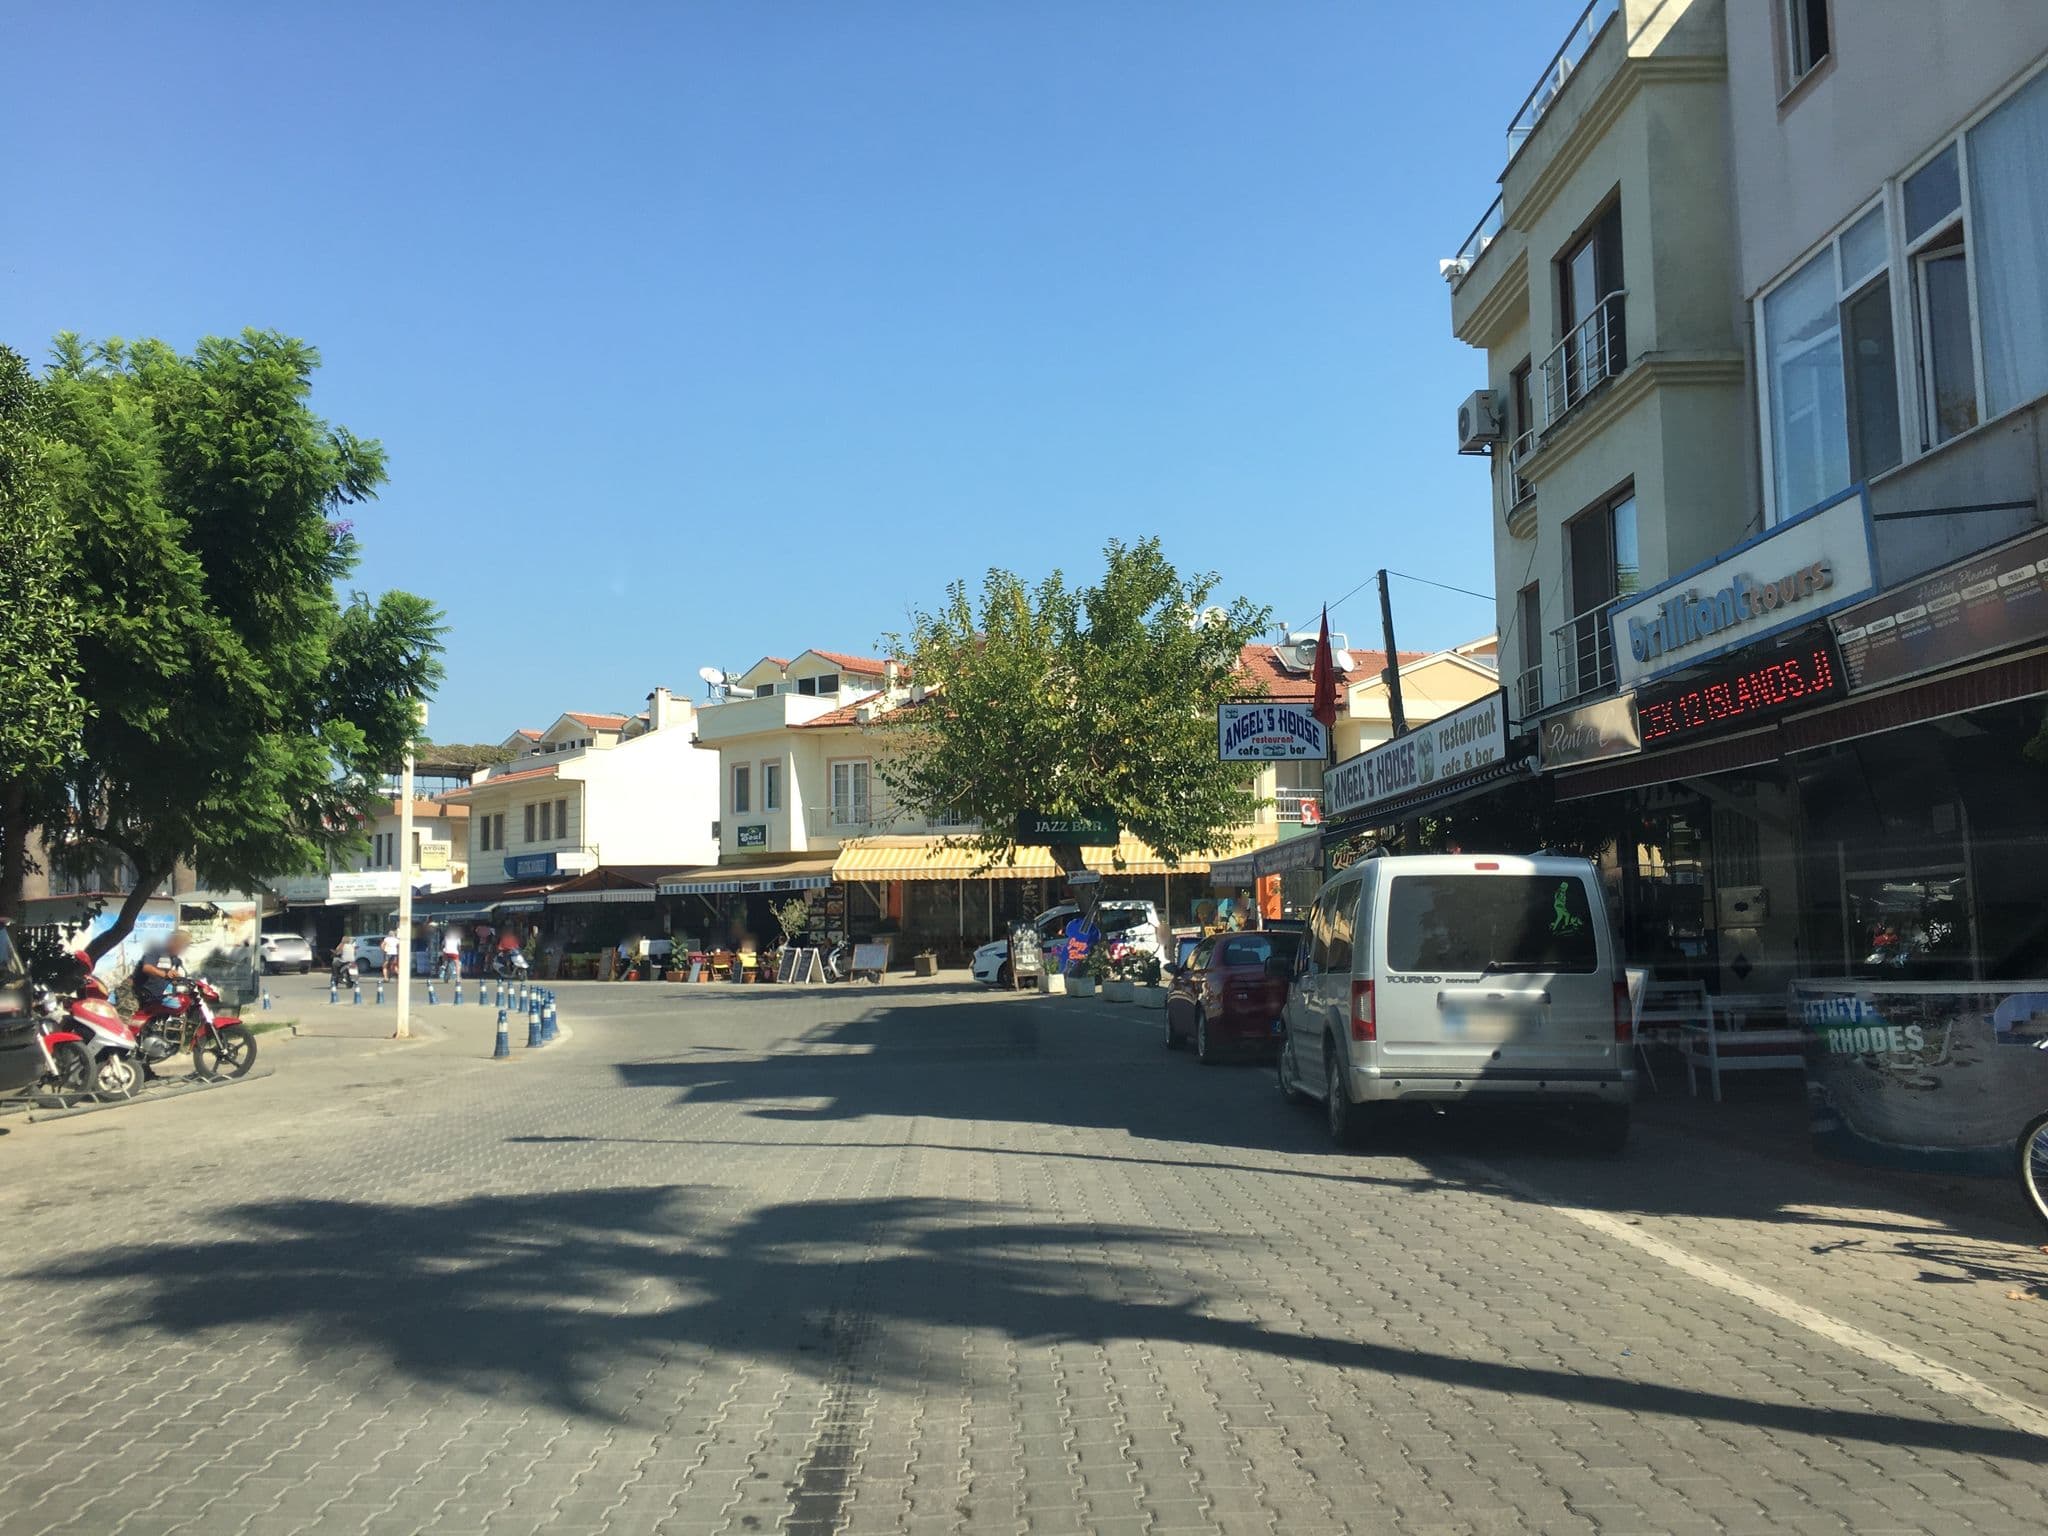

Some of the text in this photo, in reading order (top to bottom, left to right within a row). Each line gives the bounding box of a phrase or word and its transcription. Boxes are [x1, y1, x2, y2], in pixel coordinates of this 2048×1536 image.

[1746, 559, 1834, 615] tours
[1225, 708, 1321, 755] ANGEL'S HOUSE
[1252, 736, 1294, 744] restaurant
[1438, 702, 1497, 754] restaurant
[1238, 744, 1307, 755] cafe bar
[1441, 755, 1462, 777] cafe
[1475, 746, 1495, 765] bar
[1334, 740, 1418, 809] ANGEL'S HOUSE
[1034, 821, 1068, 832] JAZZ
[1385, 975, 1442, 984] TOURNEO
[1828, 1024, 1925, 1053] RHODES
